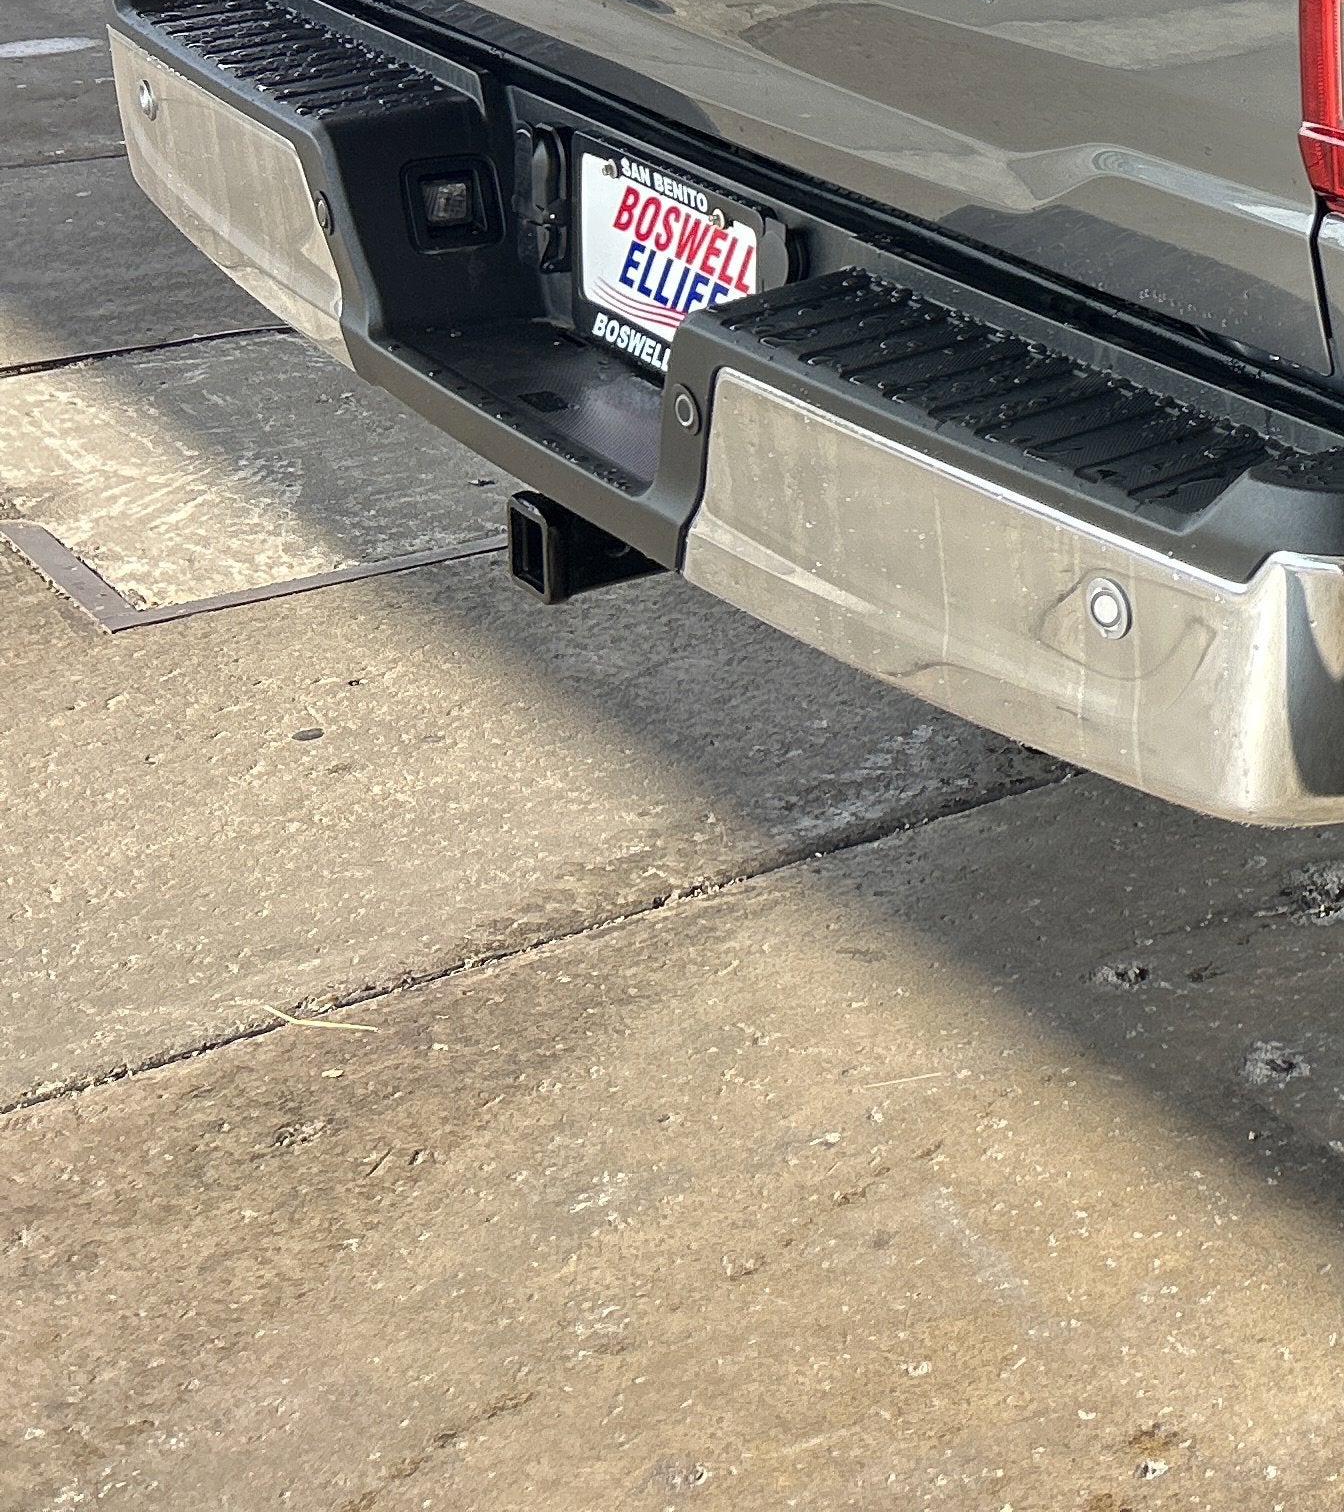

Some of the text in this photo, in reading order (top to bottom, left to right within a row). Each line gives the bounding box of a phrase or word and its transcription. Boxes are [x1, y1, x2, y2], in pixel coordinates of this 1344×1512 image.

[620, 157, 709, 214] SAN BENITO
[612, 185, 755, 294] BOSWELL
